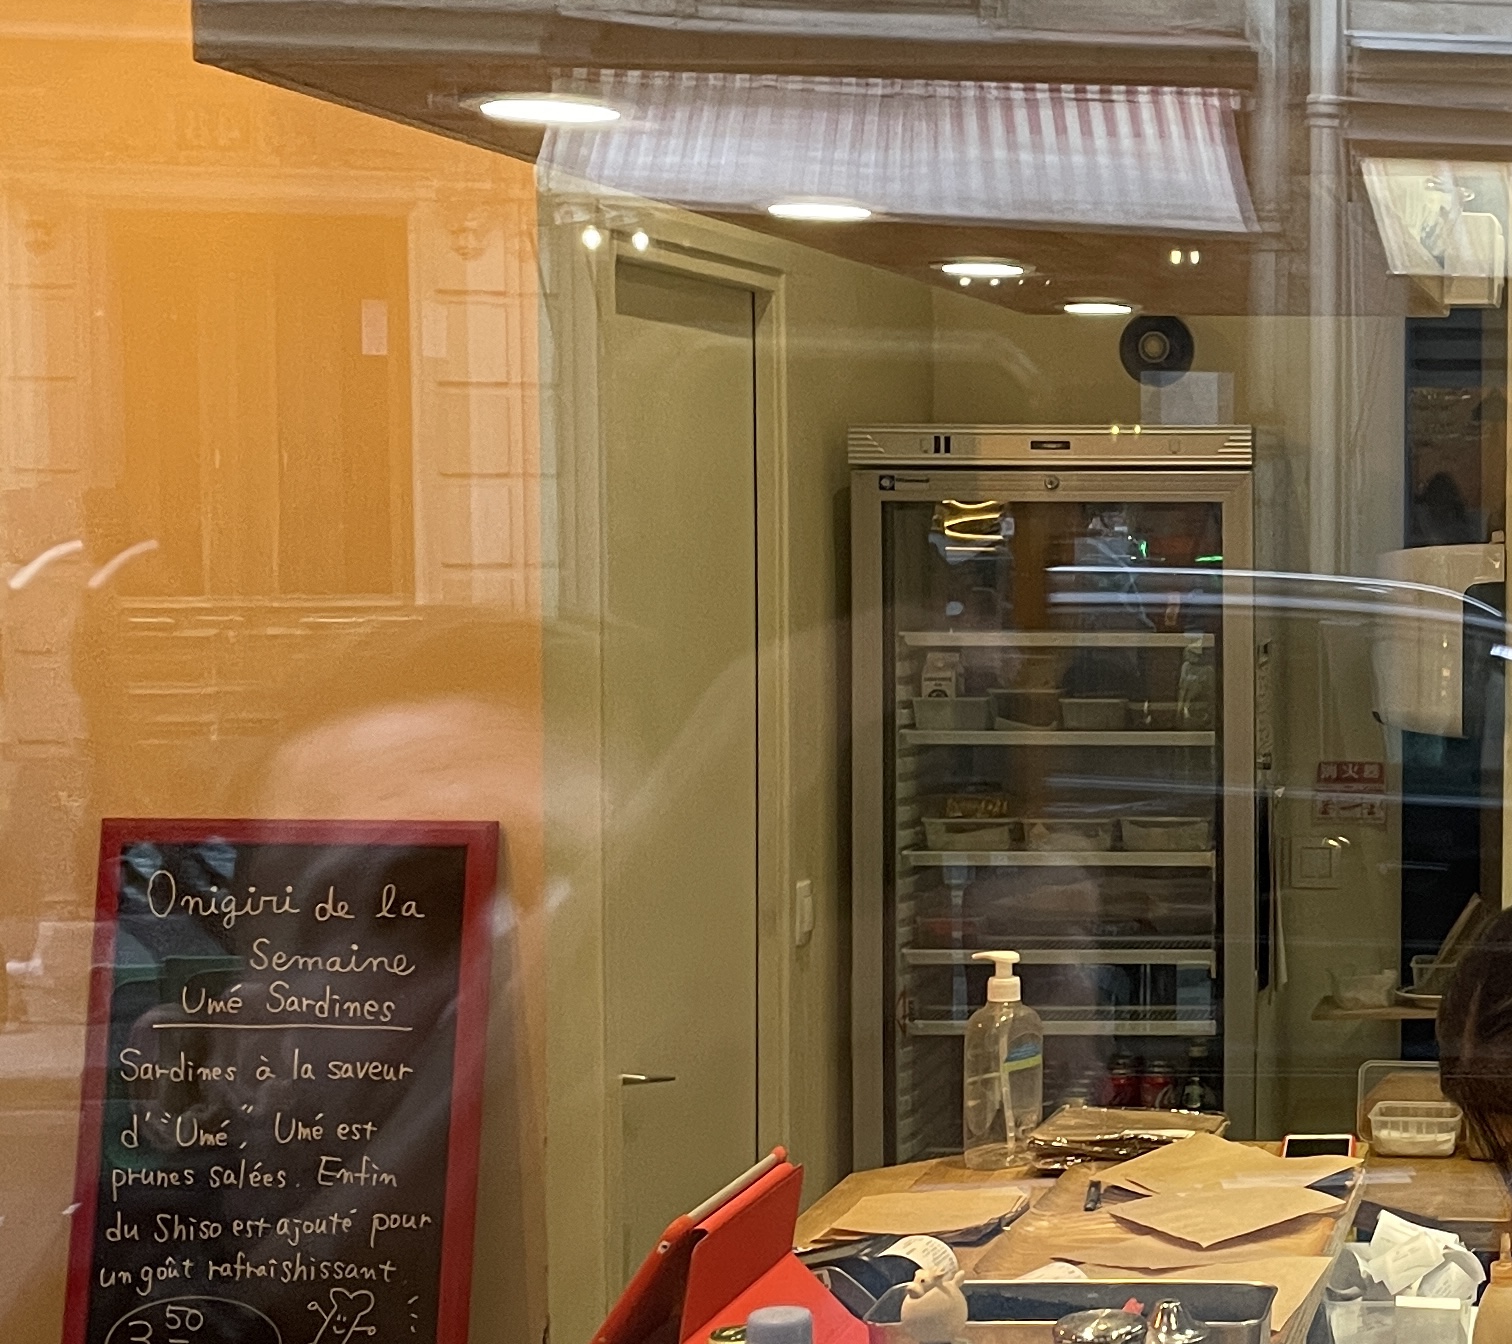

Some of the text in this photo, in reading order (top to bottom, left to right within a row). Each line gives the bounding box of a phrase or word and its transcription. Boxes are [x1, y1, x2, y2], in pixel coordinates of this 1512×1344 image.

[148, 869, 425, 929] Onigiri de la
[250, 938, 416, 976] Semaine
[181, 980, 396, 1022] Umé Sardines
[119, 1047, 414, 1083] Sardines à la saveur
[274, 1112, 324, 1144] Umé
[337, 1118, 379, 1141] est
[112, 1168, 195, 1202] prunes
[316, 1155, 398, 1187] Enfin
[105, 1208, 433, 1248] du Shiso est ajouté pour
[99, 1268, 133, 1288] un
[136, 1256, 194, 1296] goût
